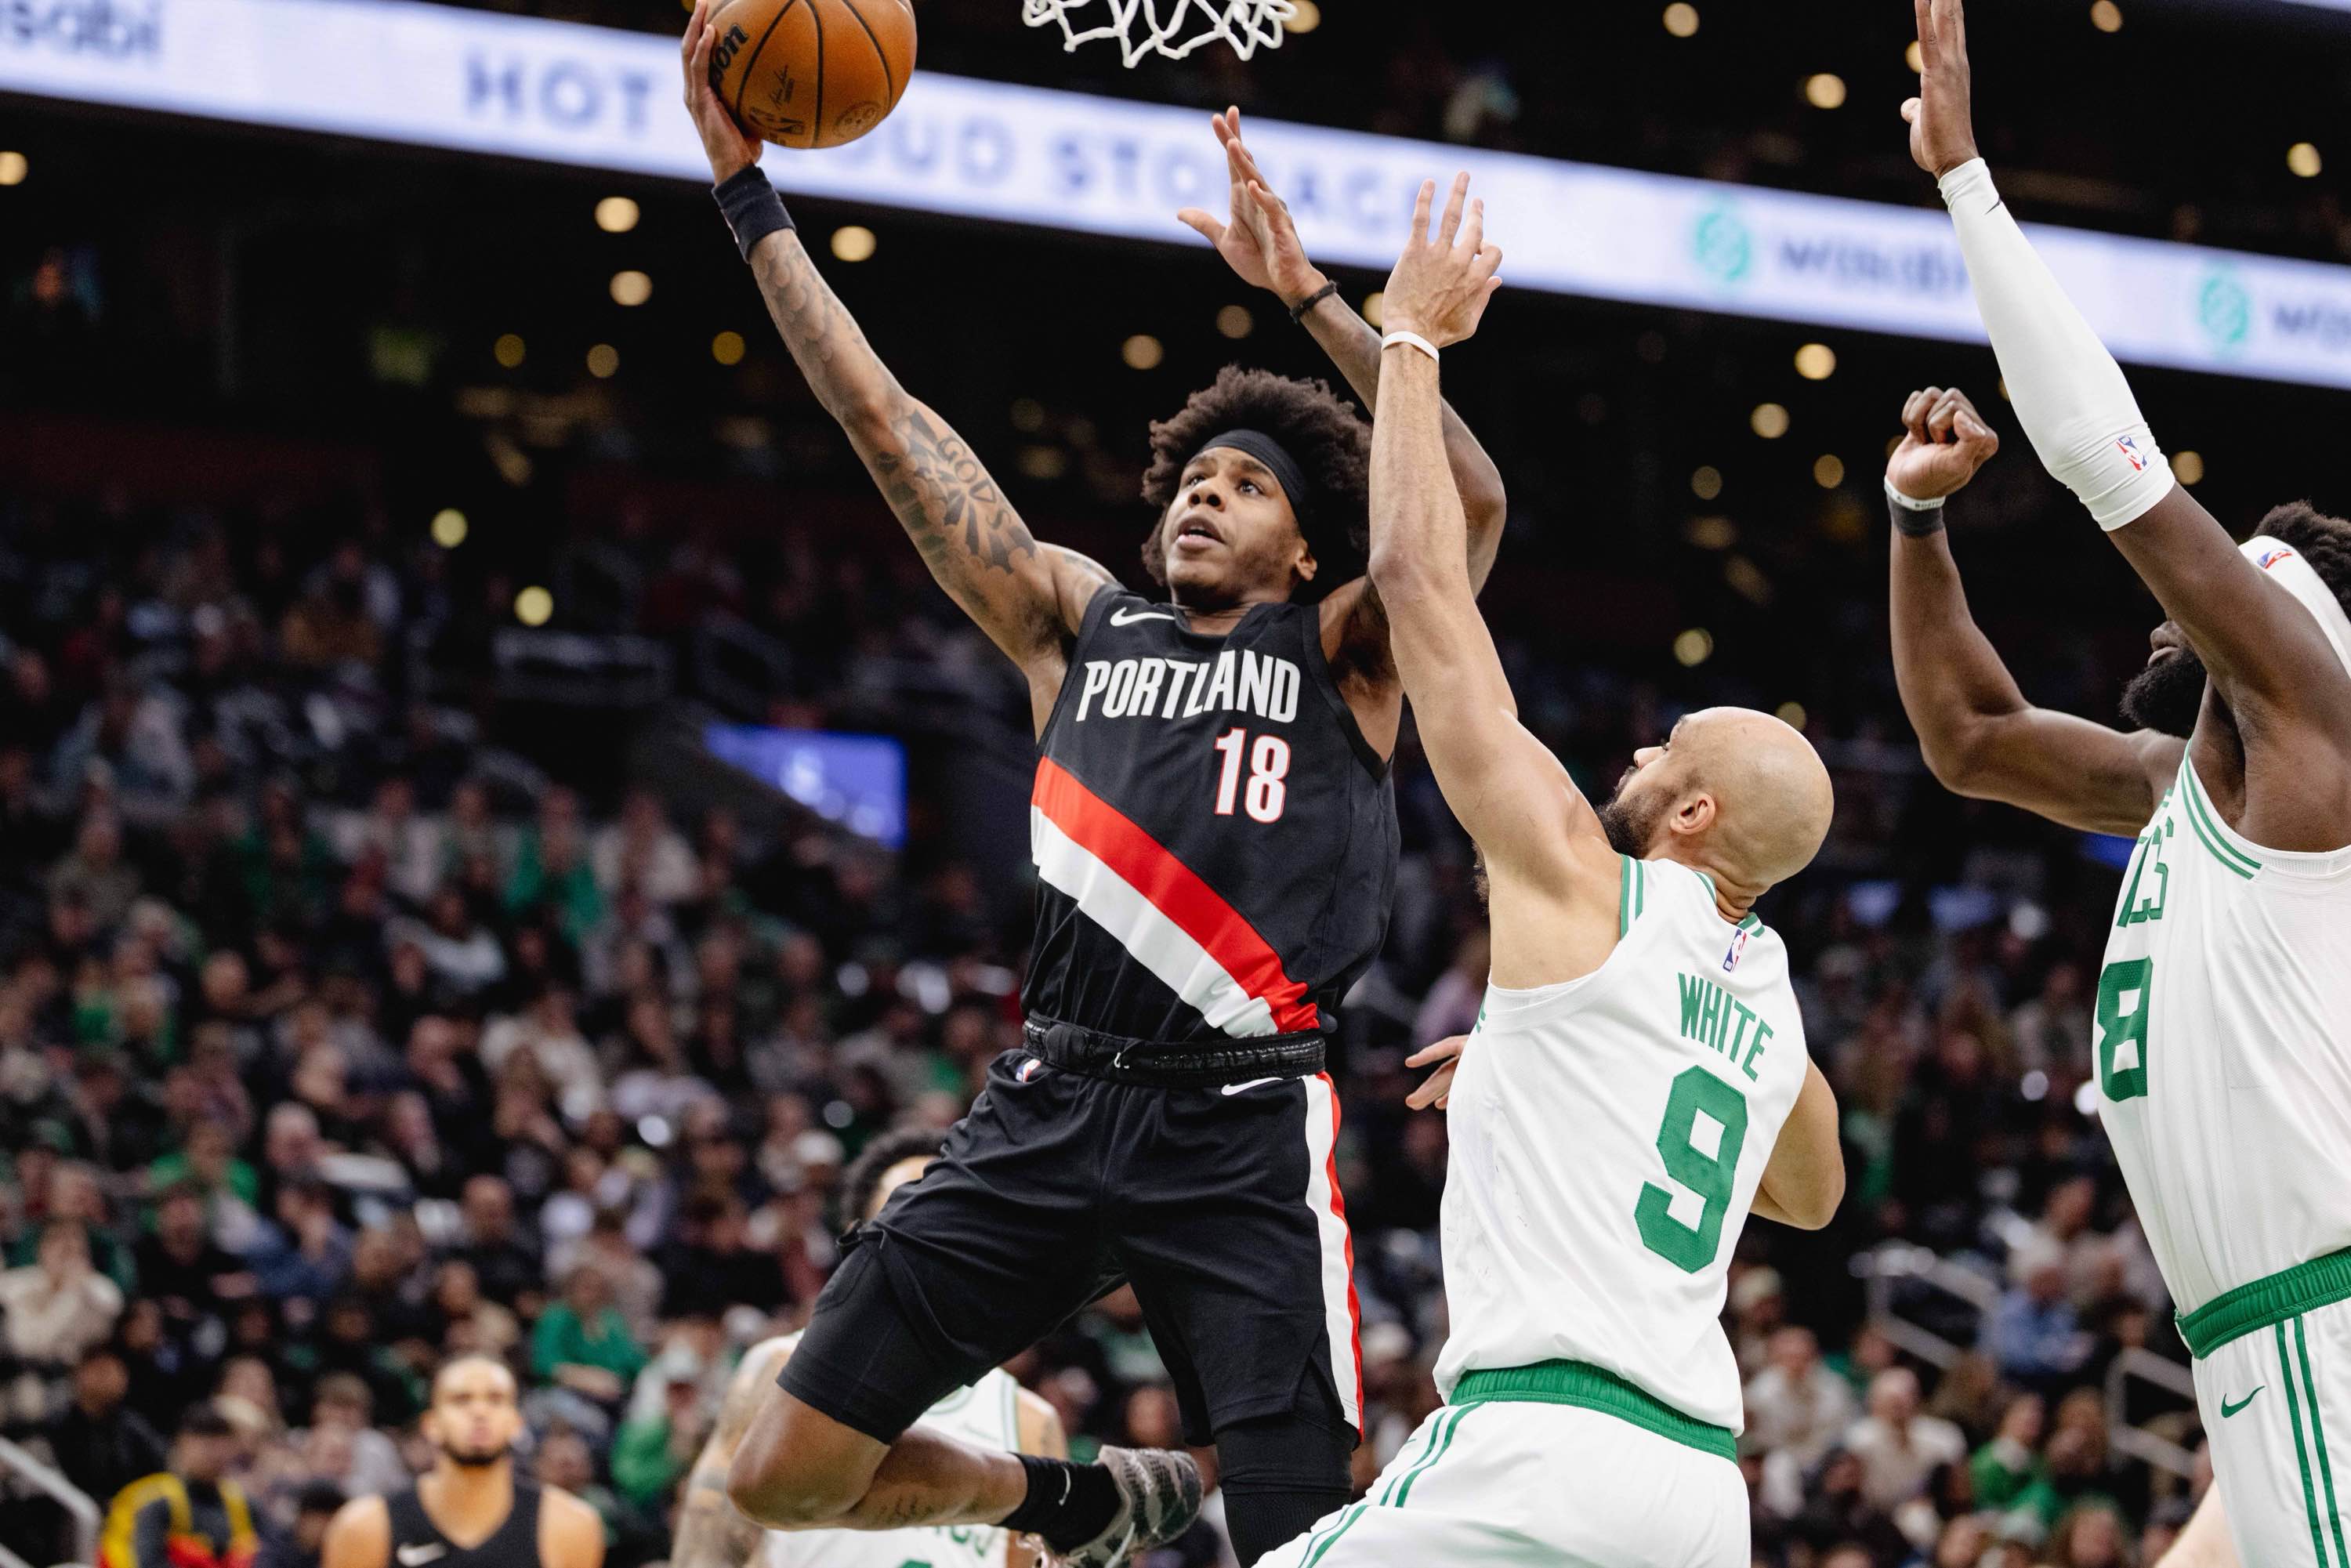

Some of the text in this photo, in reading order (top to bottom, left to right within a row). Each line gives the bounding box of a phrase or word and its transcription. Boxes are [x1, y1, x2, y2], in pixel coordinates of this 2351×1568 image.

[462, 44, 660, 138] HOT
[1075, 650, 1301, 722] PORTLAND
[1215, 727, 1291, 824] 18
[1678, 972, 1774, 1083] WHITE
[2096, 955, 2154, 1103] 8
[1633, 1064, 1749, 1275] 9
